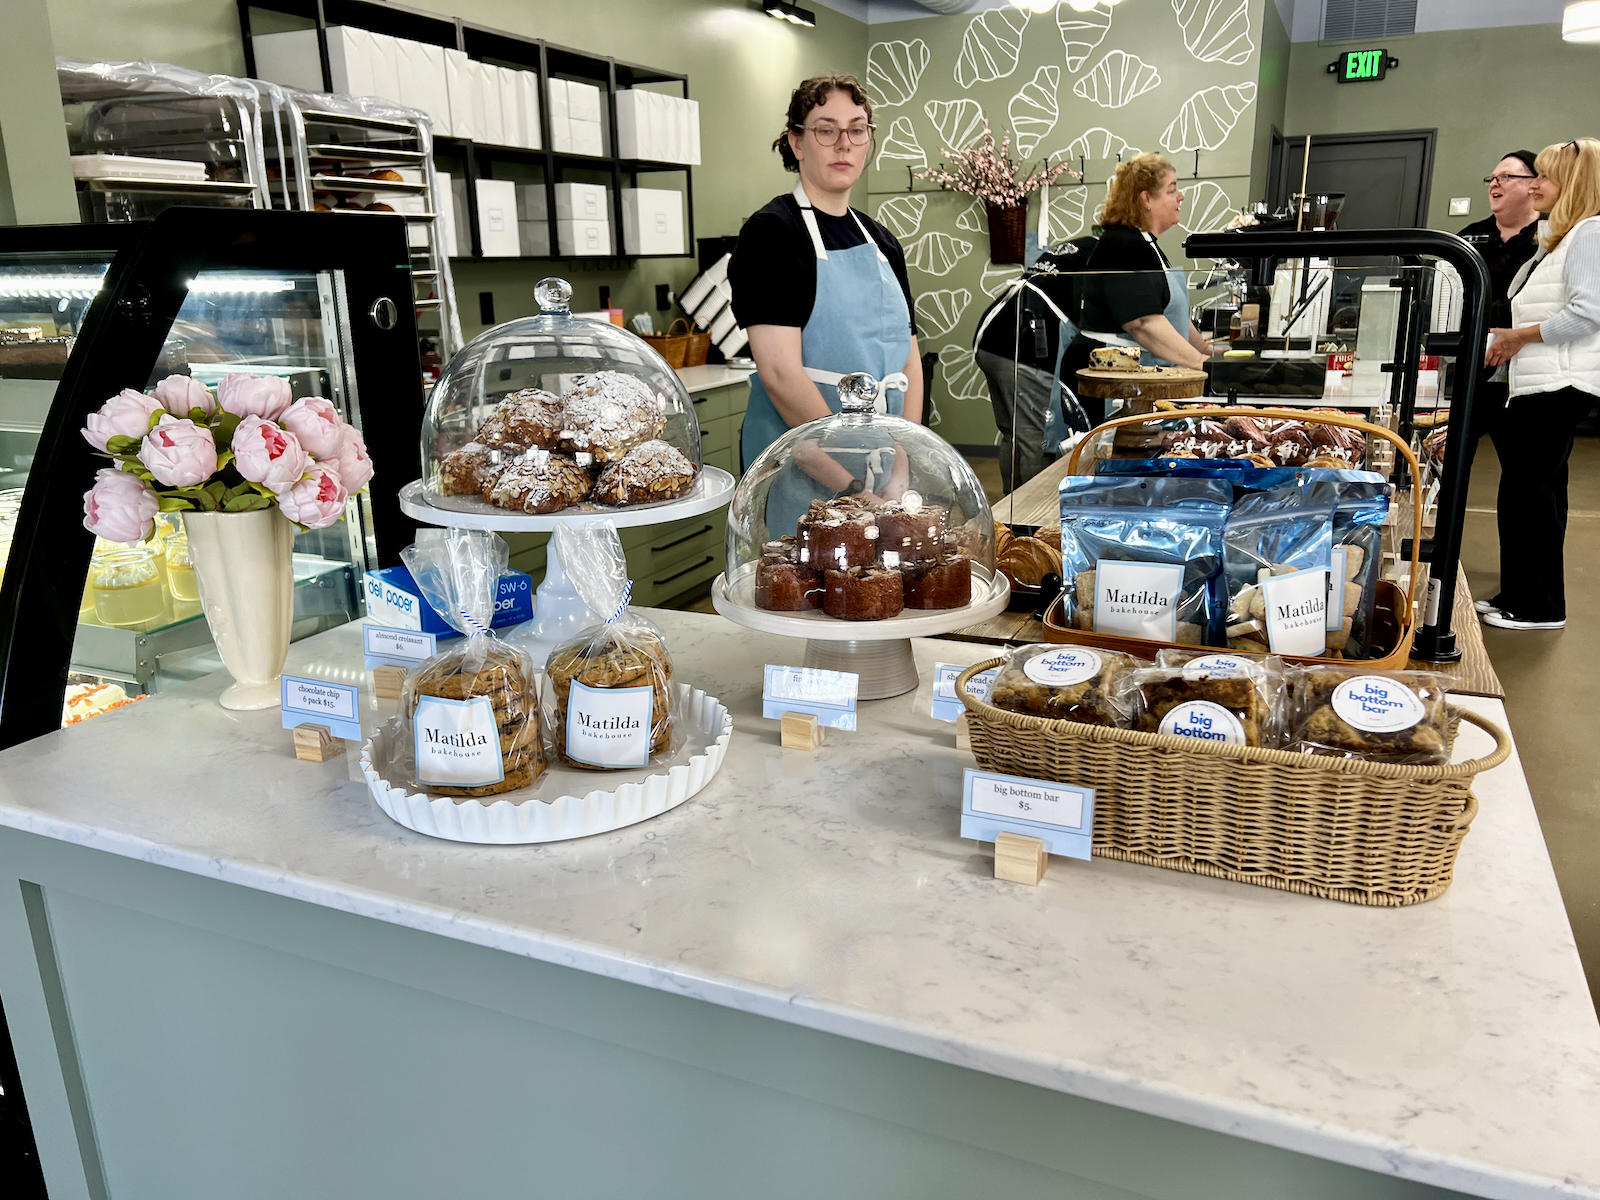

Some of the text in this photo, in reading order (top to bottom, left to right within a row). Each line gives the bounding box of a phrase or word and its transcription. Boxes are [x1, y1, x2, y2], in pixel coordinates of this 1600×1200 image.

[1346, 50, 1382, 79] EXIT
[500, 580, 527, 594] SW-6
[368, 579, 383, 599] deli
[386, 589, 413, 612] paper
[1106, 588, 1168, 606] Matilda
[1110, 606, 1159, 616] bakehouse
[1276, 598, 1325, 620] Matilda
[1284, 616, 1323, 630] bakehouse
[376, 632, 424, 645] almond croissant
[1040, 658, 1085, 667] bottom
[1056, 653, 1076, 662] big
[1216, 659, 1236, 668] big
[298, 684, 340, 700] chocolate chip
[966, 685, 984, 694] bites
[1365, 684, 1388, 699] big
[308, 697, 322, 706] pack
[323, 699, 335, 708] $15.
[1348, 690, 1403, 708] bottom
[1362, 702, 1389, 714] bar
[577, 711, 640, 730] Matilda
[1190, 711, 1212, 730] big
[424, 728, 488, 748] Matilda
[582, 729, 632, 739] bakehouse
[1174, 722, 1226, 742] bottom
[431, 747, 482, 758] bakehouse
[994, 784, 1059, 802] big bottom bar
[1018, 800, 1032, 811] $5.
